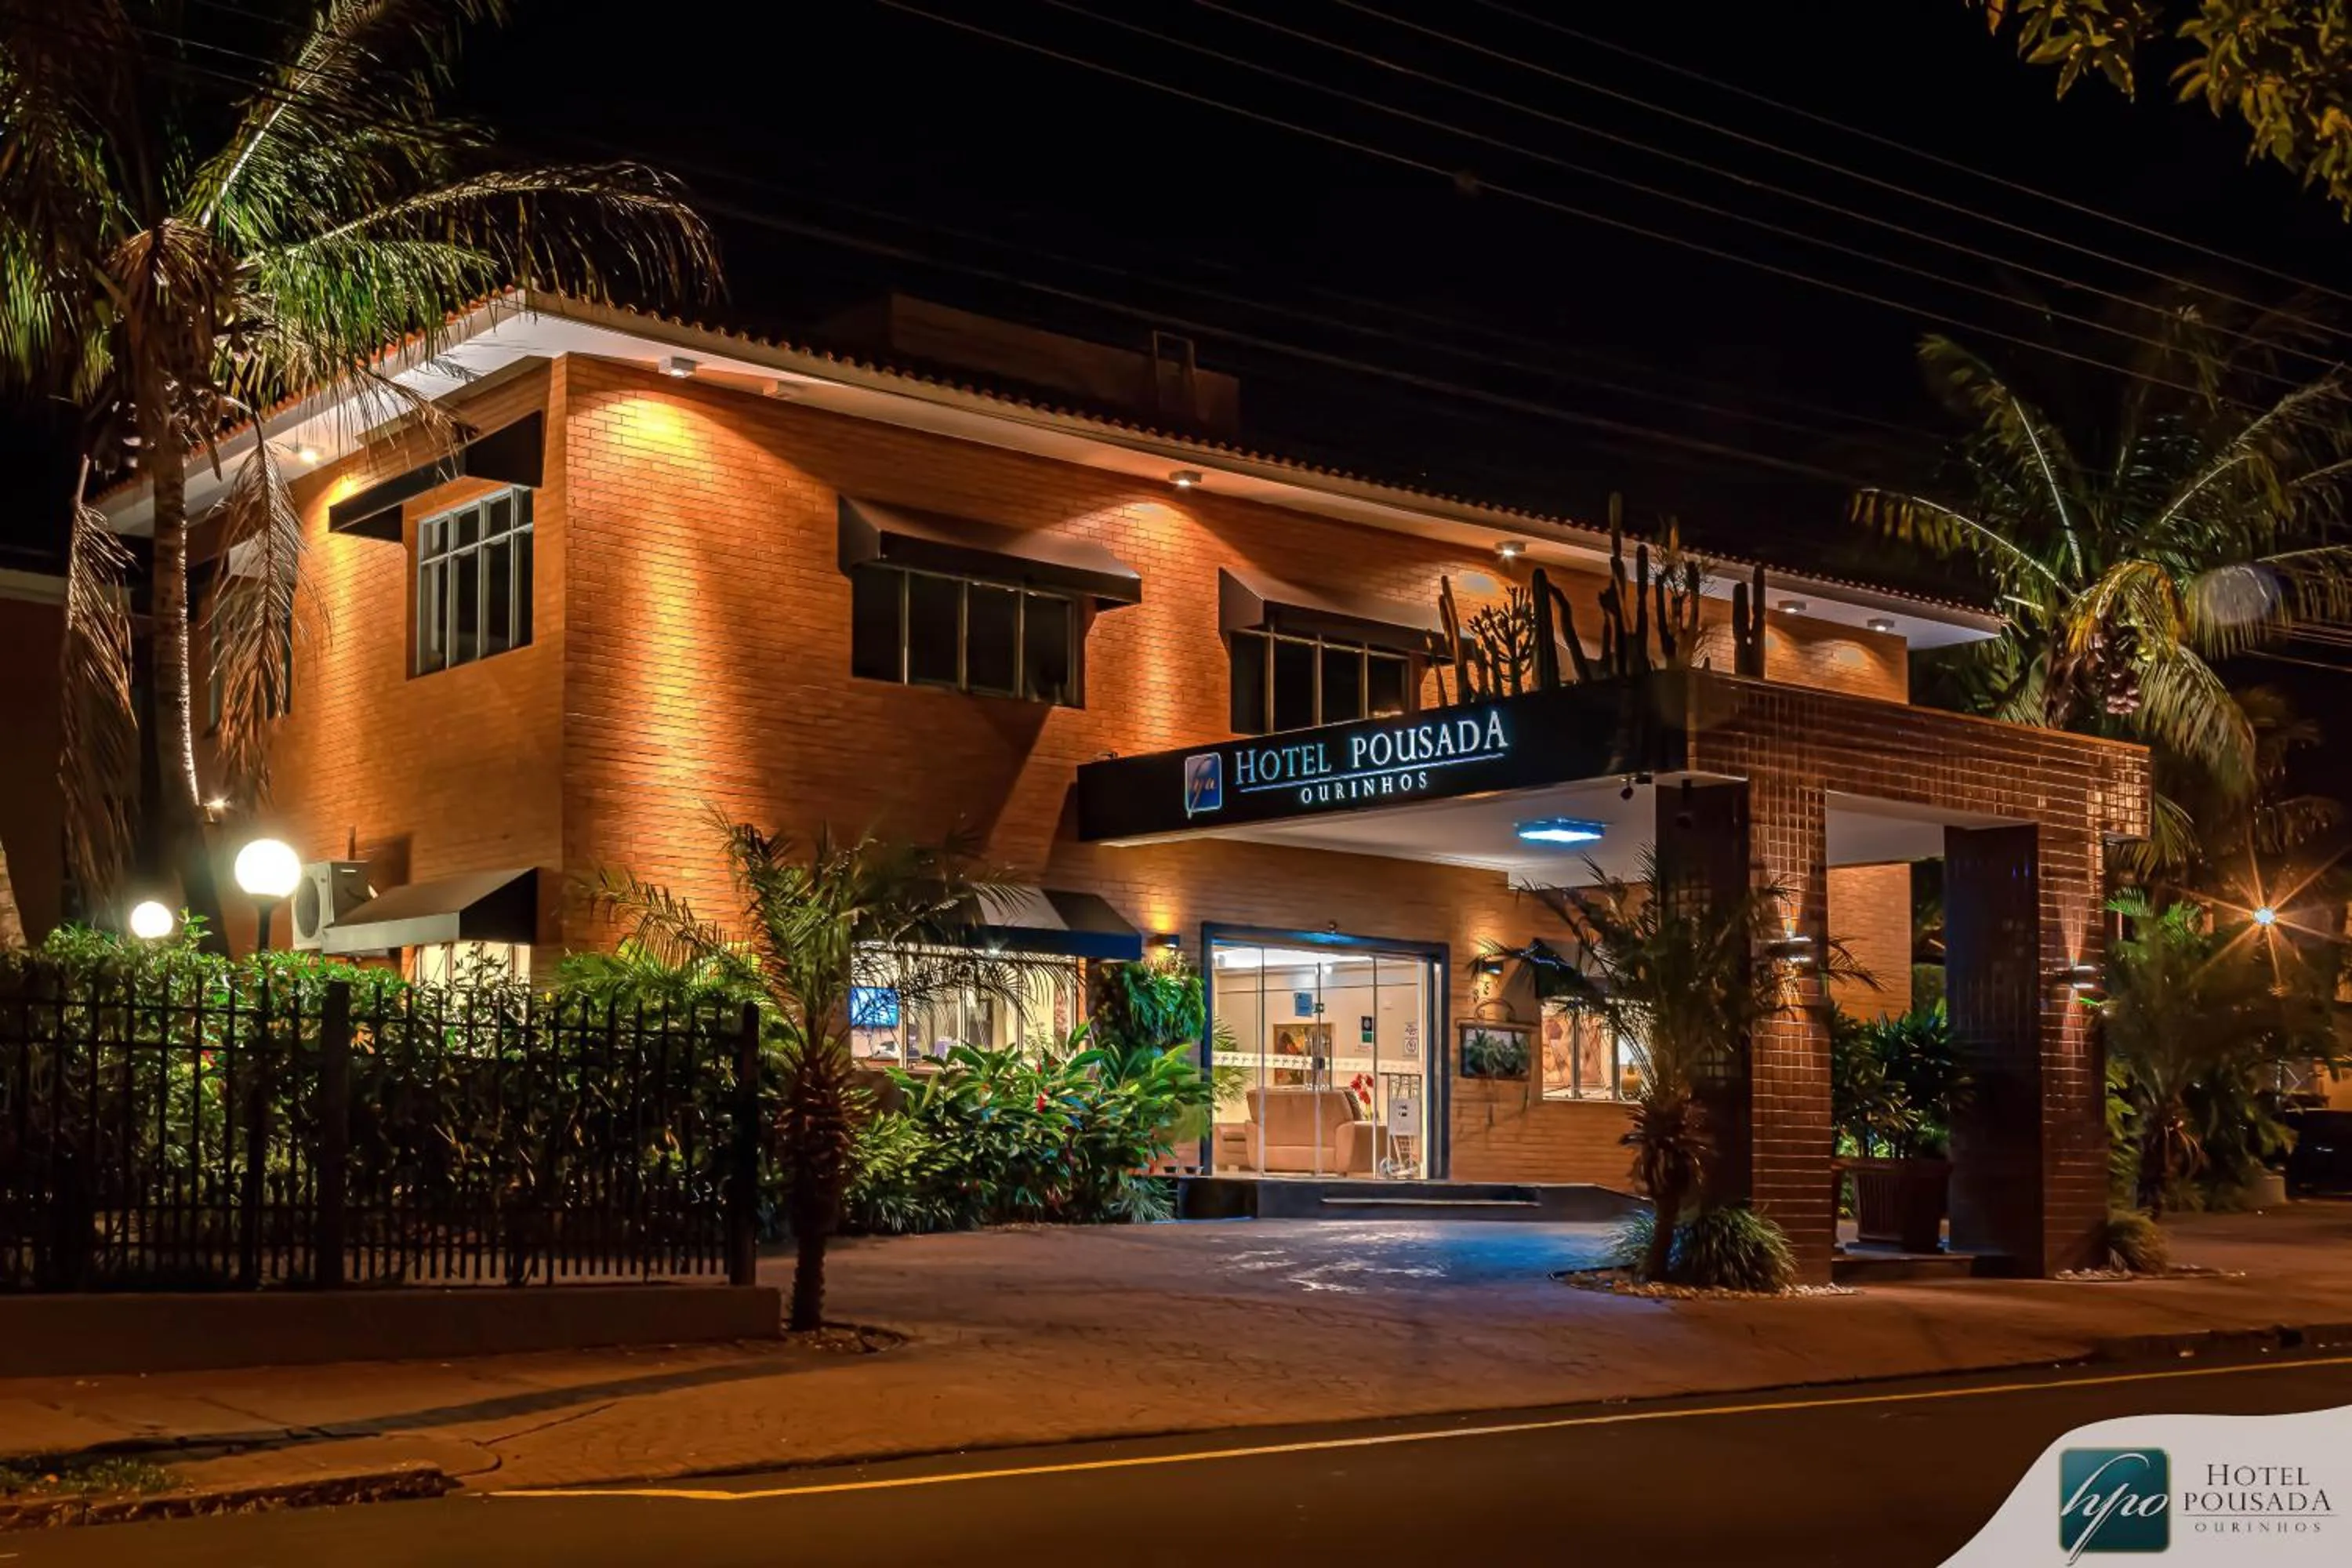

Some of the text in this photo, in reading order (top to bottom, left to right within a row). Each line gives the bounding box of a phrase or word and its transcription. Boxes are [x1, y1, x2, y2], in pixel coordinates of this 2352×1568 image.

[1236, 711, 1508, 784] HOTEL POUSADA
[1301, 771, 1428, 804] OURINHOS
